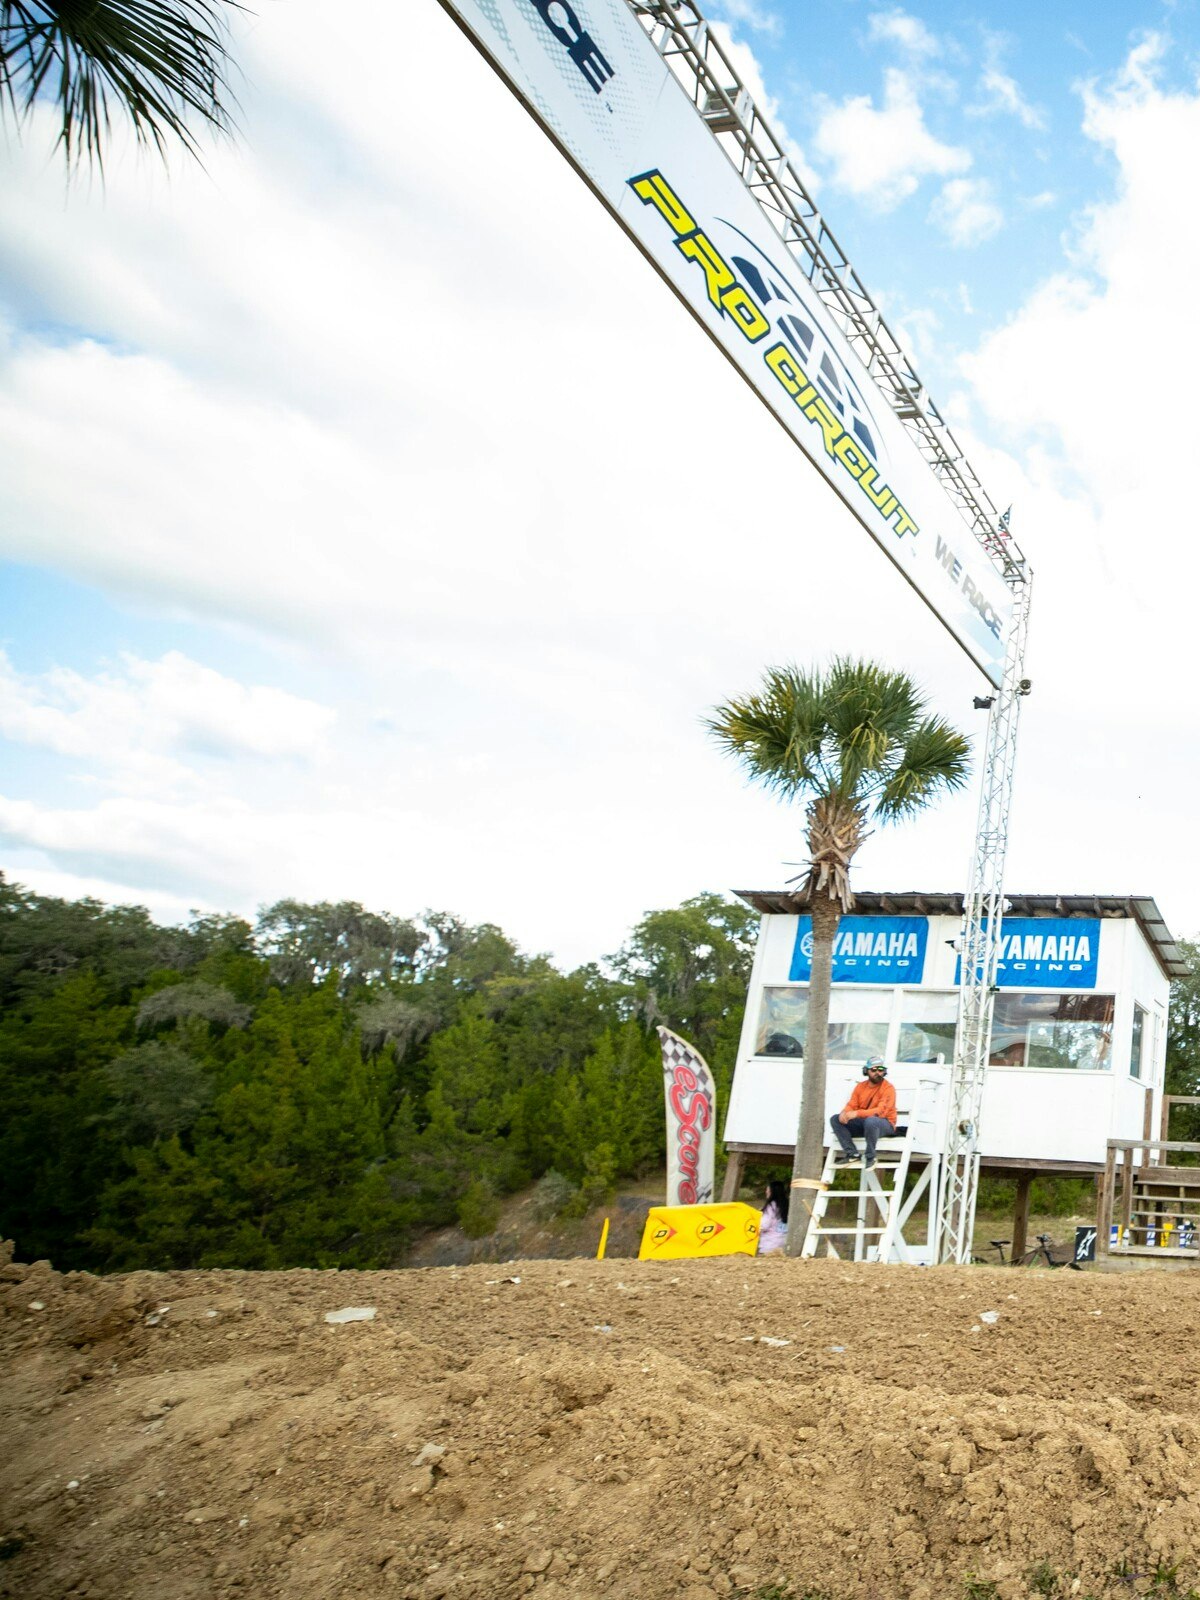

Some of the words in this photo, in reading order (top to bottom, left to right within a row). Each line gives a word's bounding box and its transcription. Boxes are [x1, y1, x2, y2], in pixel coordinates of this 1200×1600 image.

[529, 0, 616, 95] CE
[625, 168, 770, 345] PRO
[763, 341, 920, 539] CIRCUIT
[935, 534, 963, 584] WE
[961, 574, 1003, 640] RACE
[831, 931, 918, 957] YAMAHA
[995, 934, 1091, 961] YAMAHA
[670, 1065, 711, 1205] eScore
